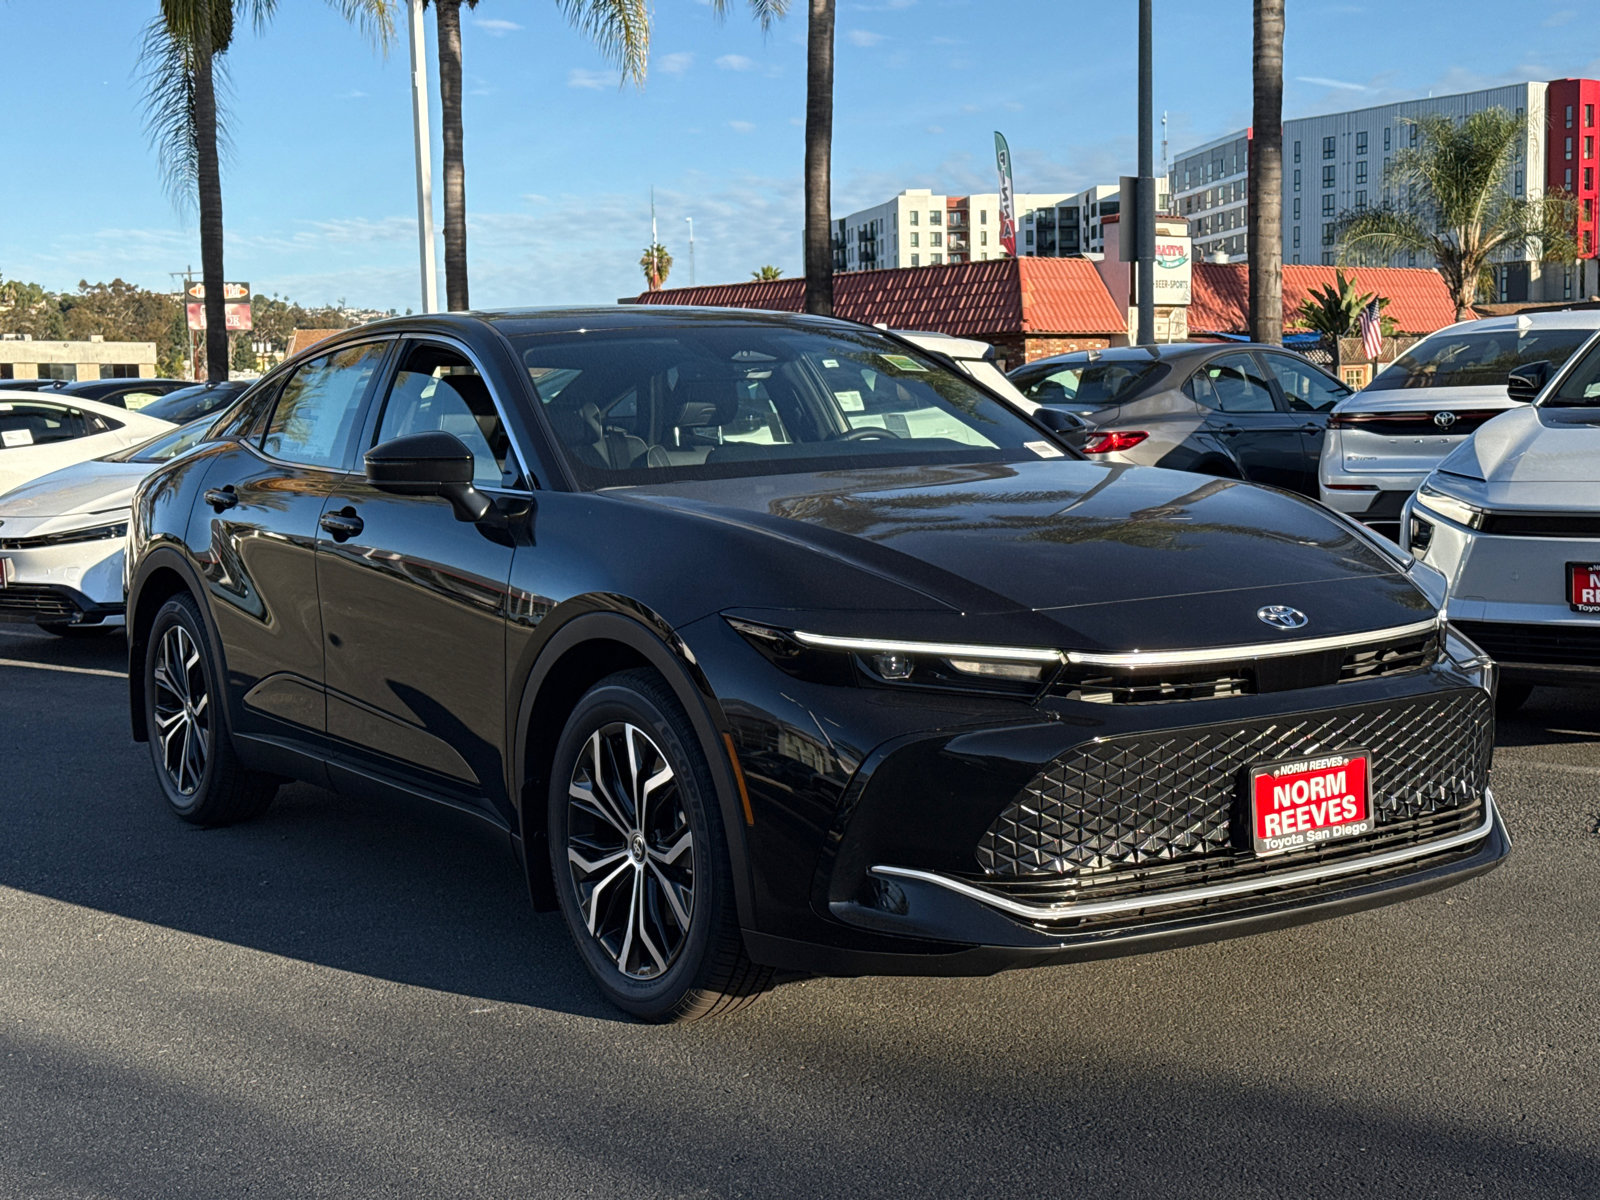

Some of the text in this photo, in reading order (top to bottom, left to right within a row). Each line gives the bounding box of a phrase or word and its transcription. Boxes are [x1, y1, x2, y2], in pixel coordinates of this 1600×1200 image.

[1280, 756, 1343, 776] NORM REEVES
[1273, 771, 1347, 810] NORM
[1264, 794, 1357, 837] REEVES
[1263, 823, 1367, 849] Toyota San Diego
